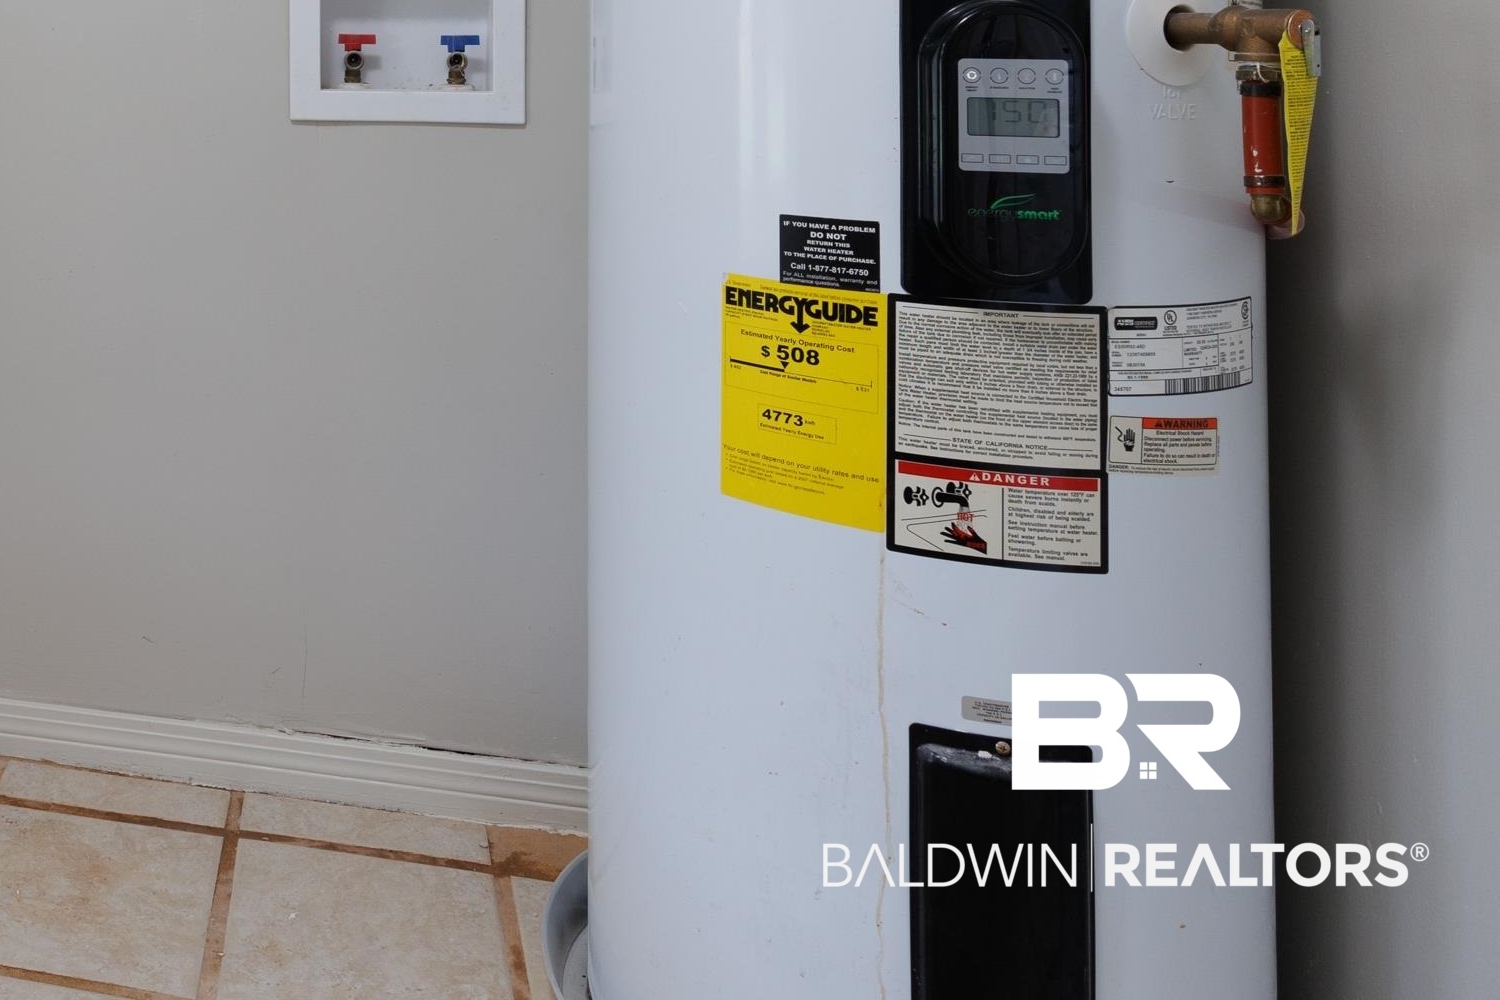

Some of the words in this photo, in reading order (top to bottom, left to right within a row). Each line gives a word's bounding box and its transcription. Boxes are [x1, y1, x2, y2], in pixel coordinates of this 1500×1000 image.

[1148, 104, 1196, 120] VALVE
[791, 262, 805, 270] Call
[808, 264, 868, 276] 1-877-817-6750
[740, 329, 773, 341] Estimated
[775, 335, 796, 345] Yearly
[798, 339, 834, 351] Operating
[836, 344, 854, 353] Cost
[761, 345, 770, 358] $
[777, 344, 820, 366] 508
[762, 408, 803, 427] 4773
[1164, 419, 1208, 428] WARNING
[723, 443, 736, 452] Your
[762, 454, 785, 465] depend
[796, 462, 811, 472] your
[812, 464, 830, 475] utility
[832, 468, 849, 478] rates
[851, 473, 864, 481] and
[982, 471, 1050, 487] DANGER
